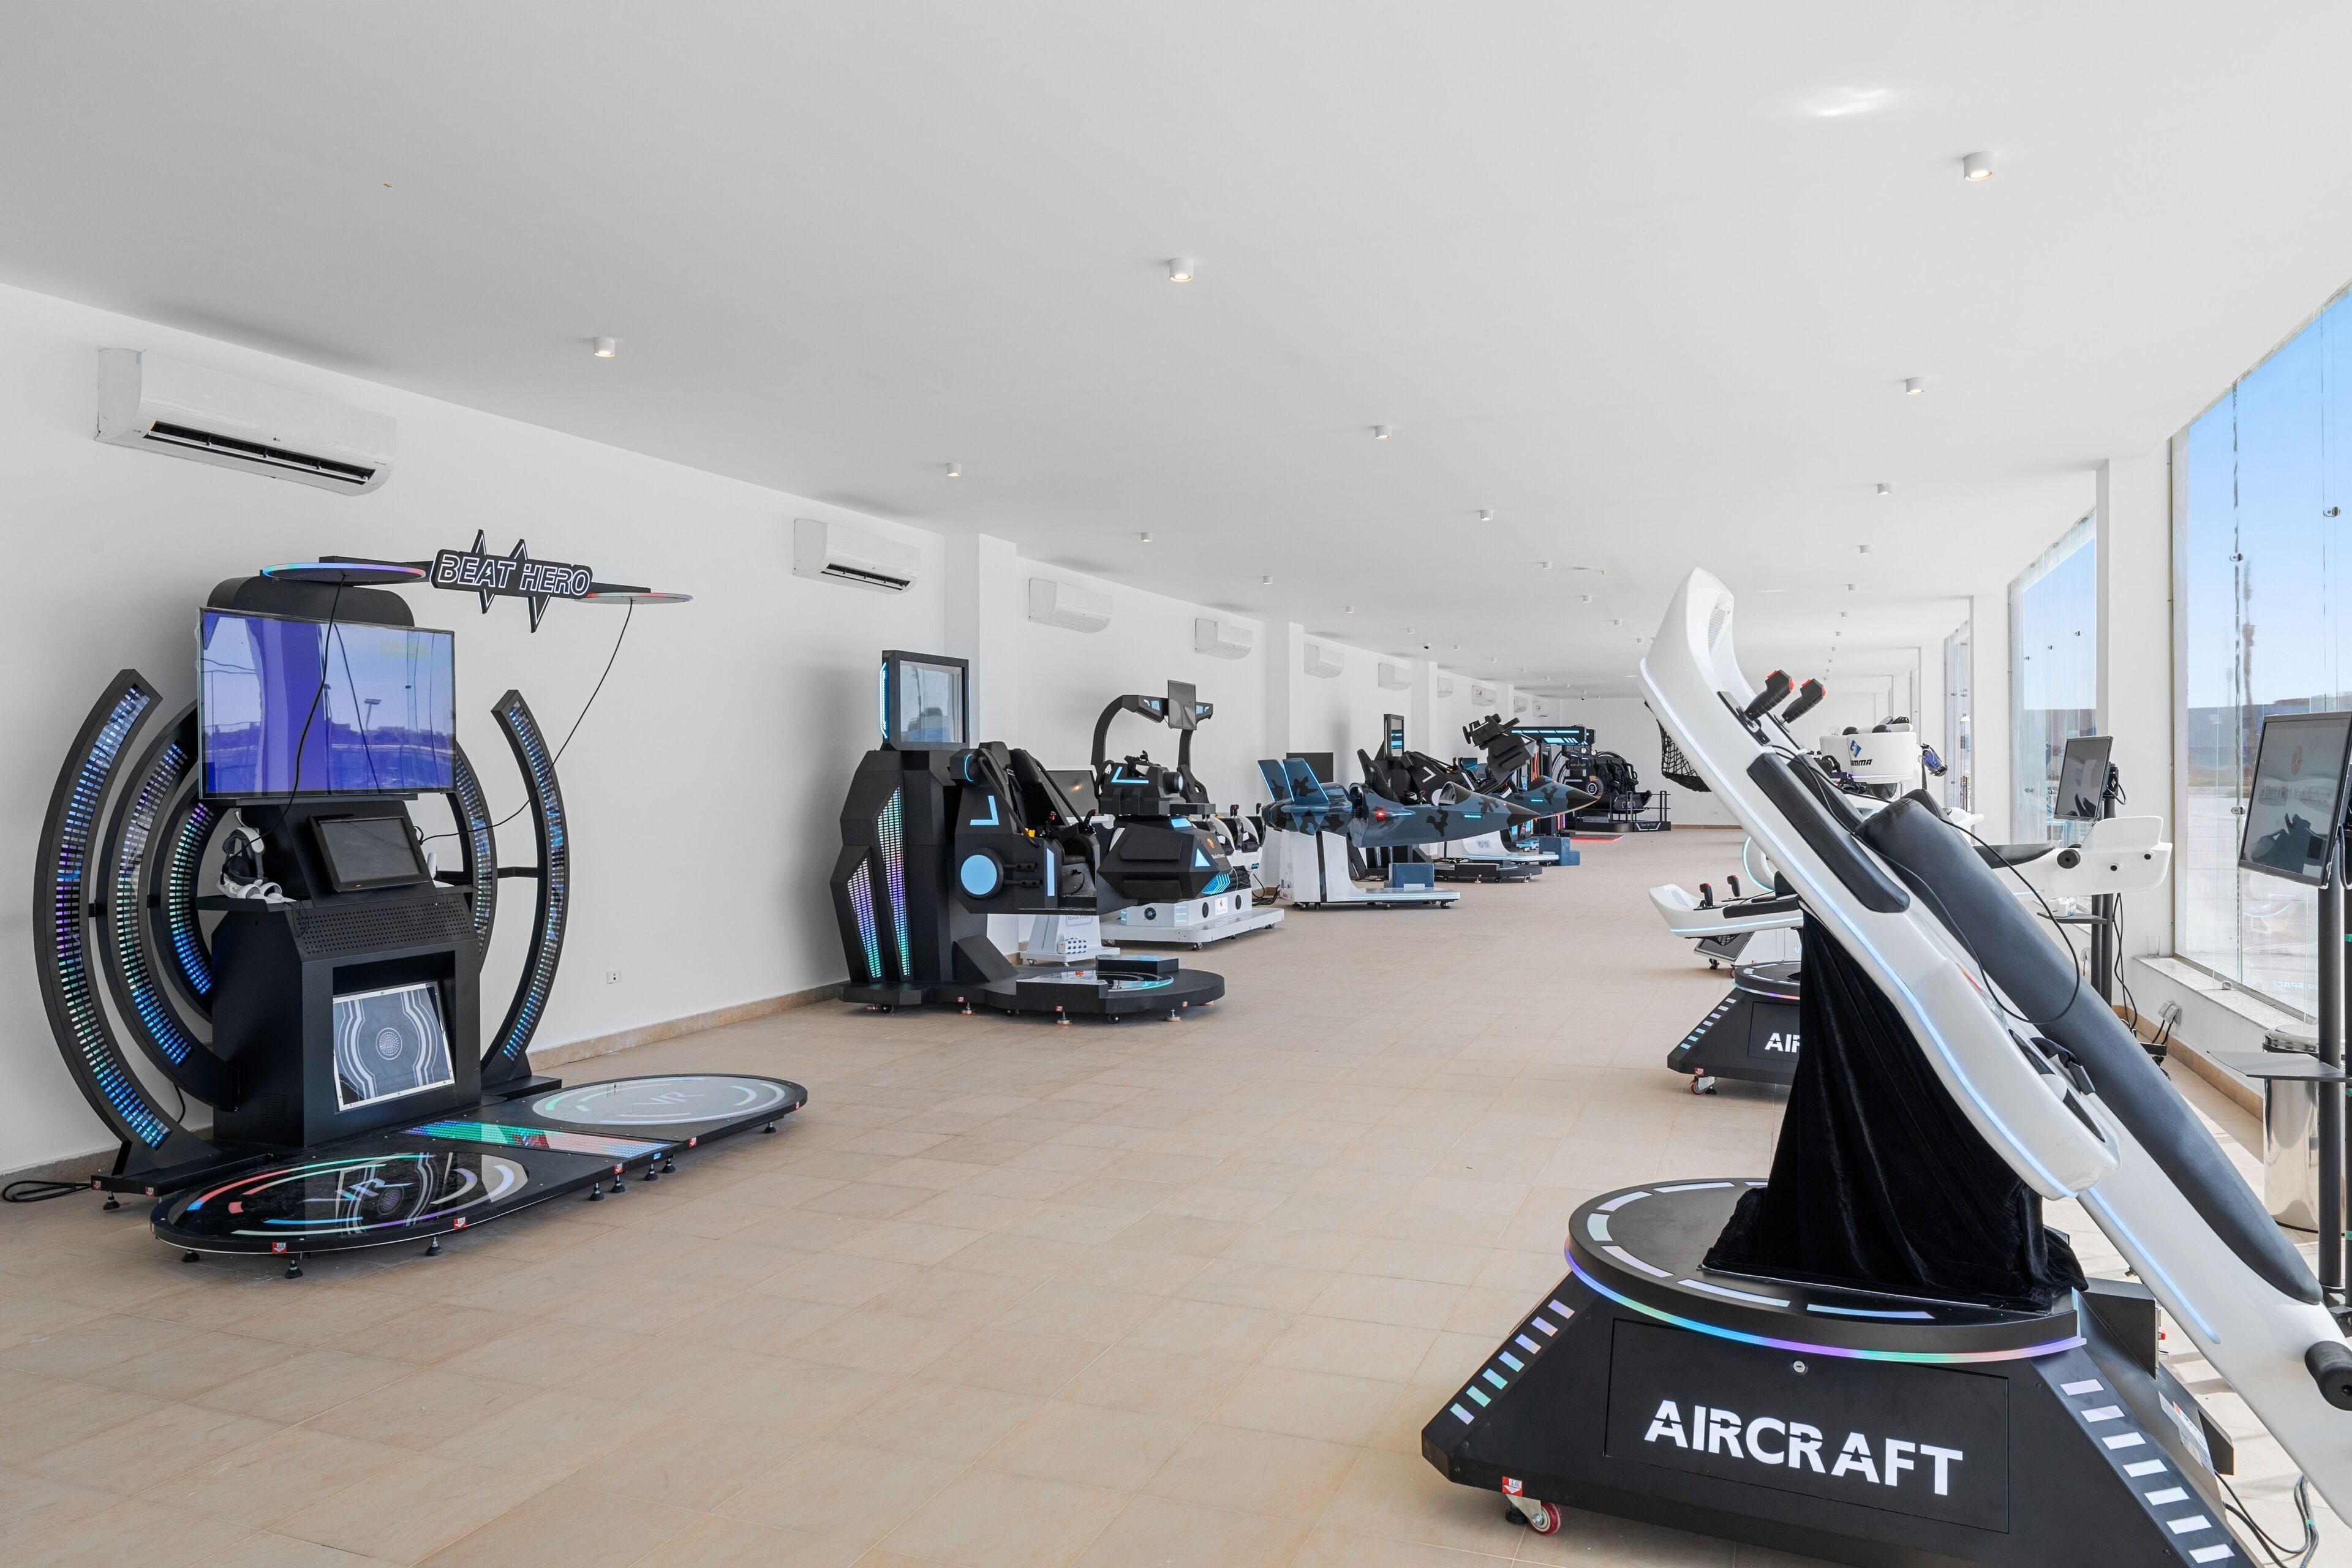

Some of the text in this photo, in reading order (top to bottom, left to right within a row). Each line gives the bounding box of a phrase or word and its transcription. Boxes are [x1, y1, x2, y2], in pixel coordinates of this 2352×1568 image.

[437, 553, 592, 597] BEAT HERO
[1643, 1399, 1964, 1496] AIRCRAFT
